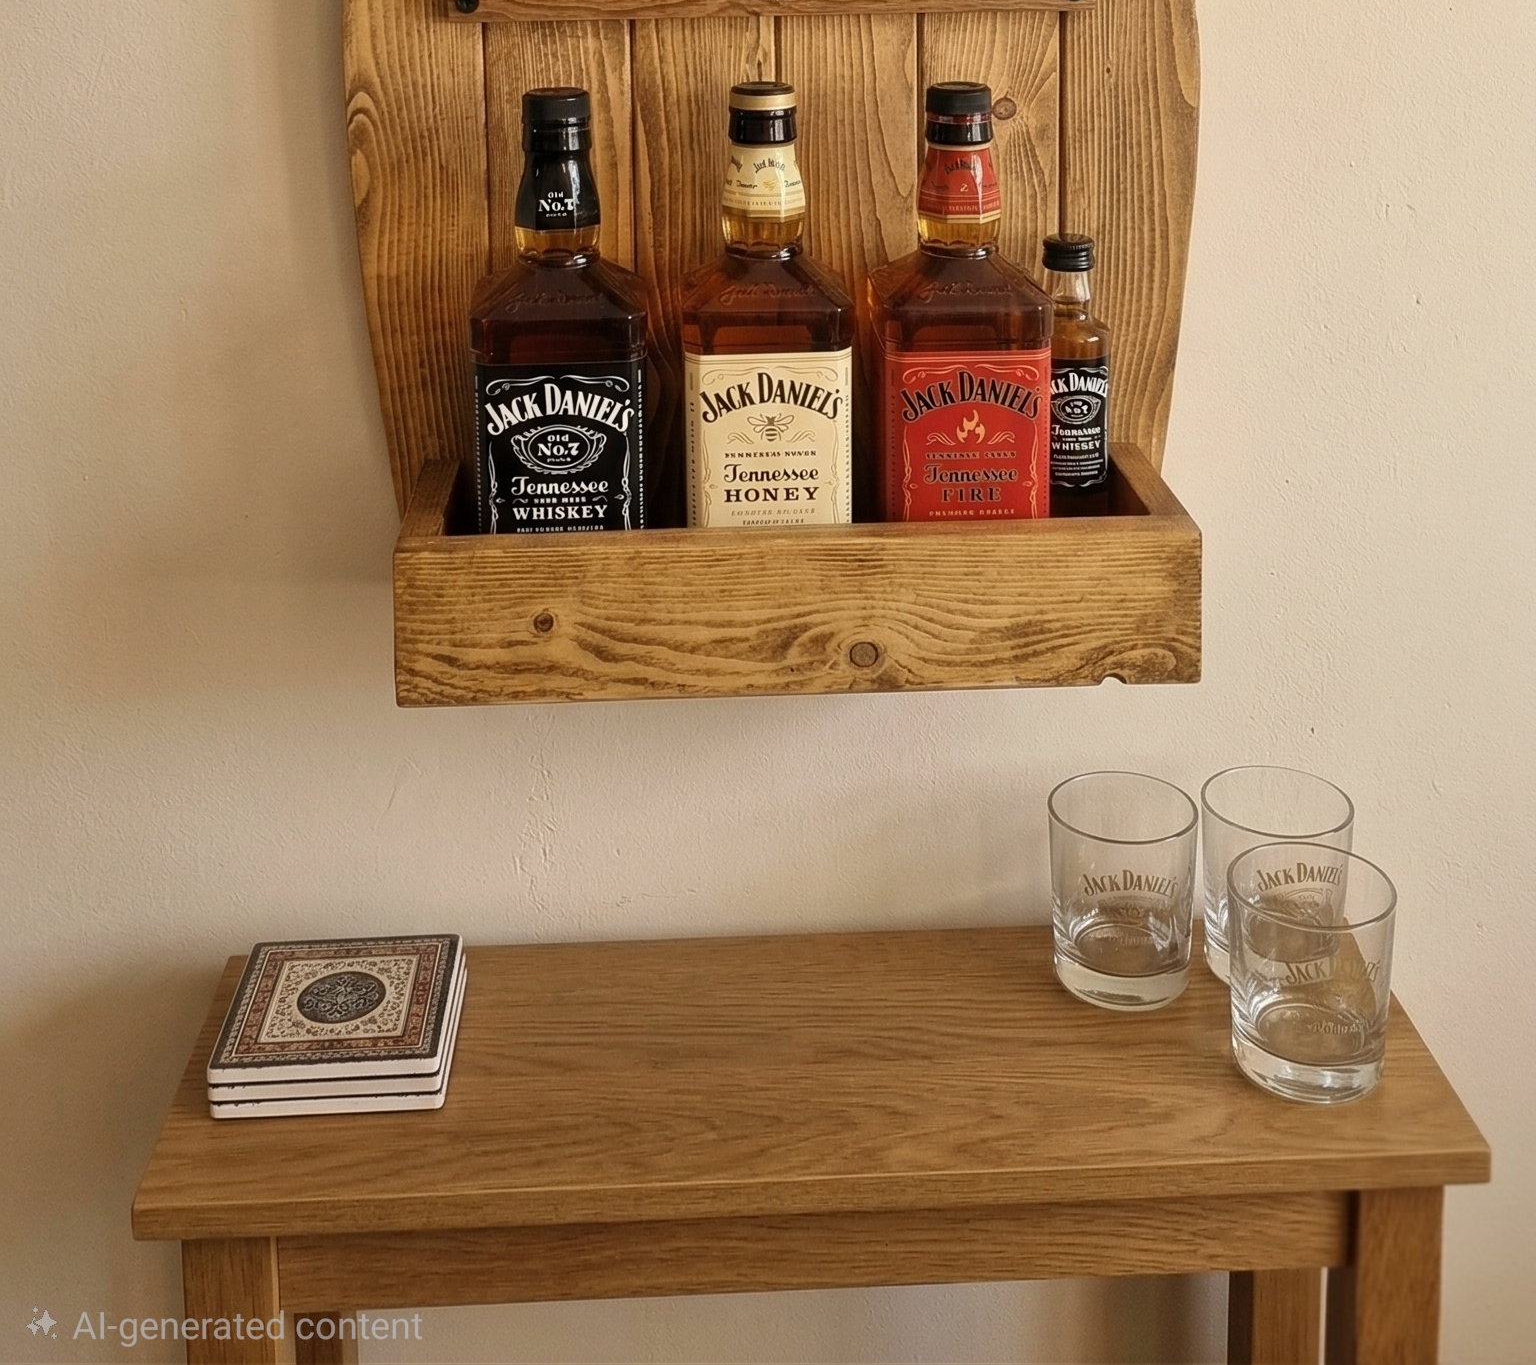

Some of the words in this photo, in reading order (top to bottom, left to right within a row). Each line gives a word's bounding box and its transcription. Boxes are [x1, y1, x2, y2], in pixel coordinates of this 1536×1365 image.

[699, 382, 755, 423] JACK
[757, 372, 843, 420] DANIEL'S
[900, 380, 956, 423] JACK
[957, 370, 1043, 420] DANIEL'S
[484, 392, 543, 436] JACK
[543, 383, 635, 432] DANIEL'S
[547, 434, 569, 442] Old
[723, 463, 819, 483] Tennessee
[923, 463, 1018, 484] Tennessee
[511, 476, 609, 495] Tennessee
[724, 486, 819, 502] HONEY
[942, 487, 1001, 502] FIRE
[512, 505, 608, 520] WHISKEY
[1082, 873, 1121, 897] JACK
[1256, 867, 1295, 892] JACK
[1285, 962, 1326, 985] JACK
